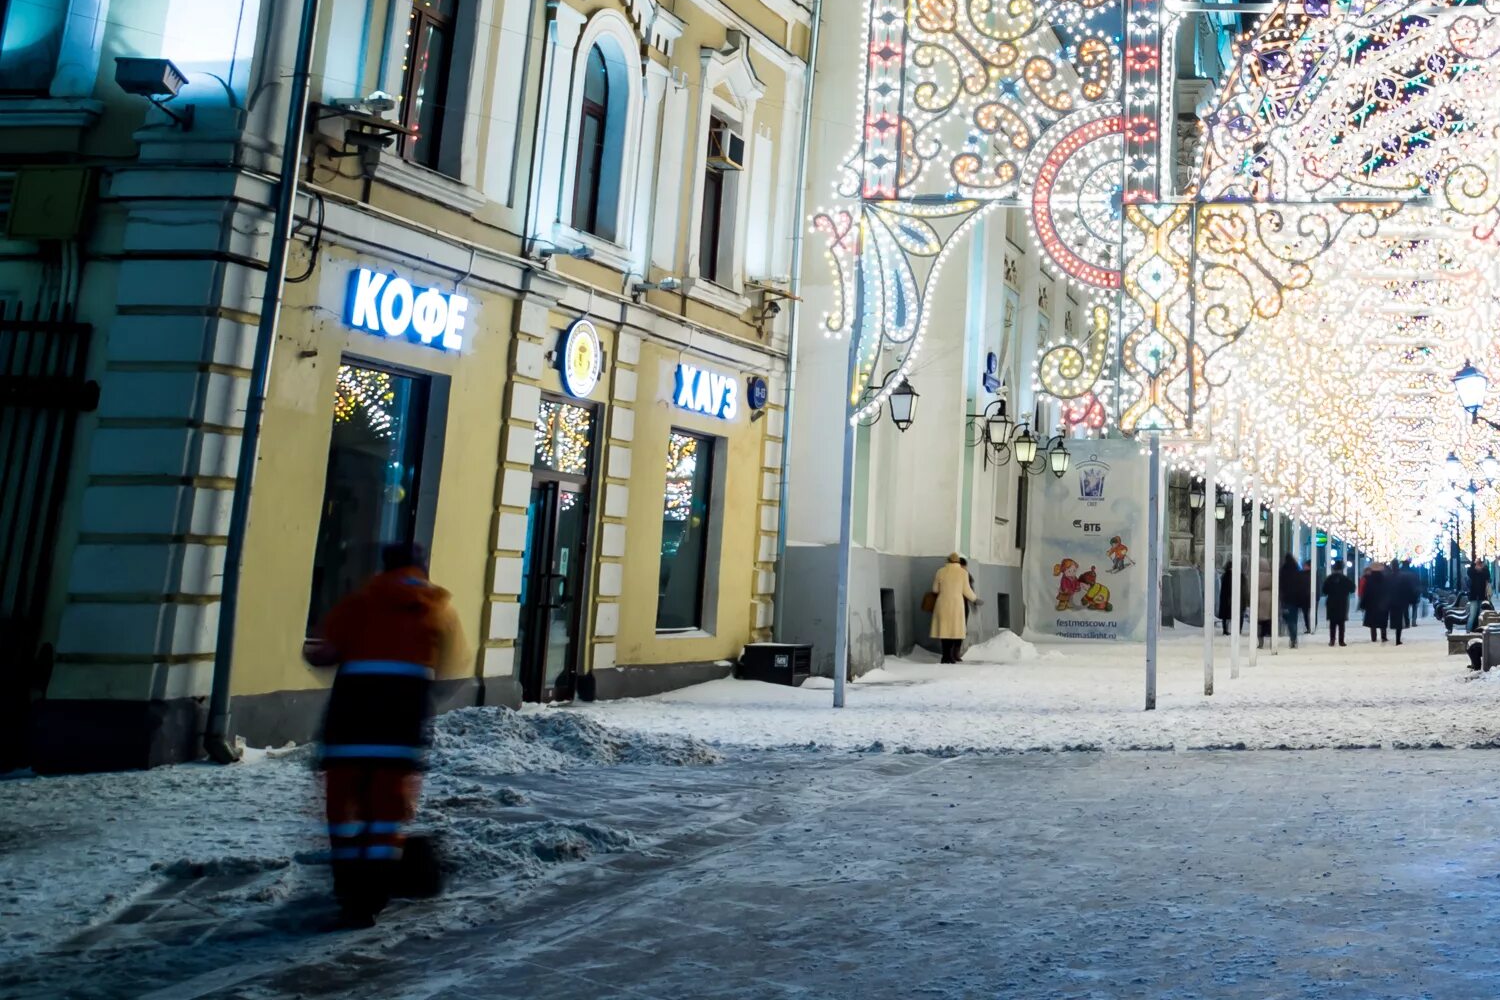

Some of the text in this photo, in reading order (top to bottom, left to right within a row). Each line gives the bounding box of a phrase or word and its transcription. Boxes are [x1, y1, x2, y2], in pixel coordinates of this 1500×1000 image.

[352, 268, 468, 350] КОФЕ
[678, 364, 738, 420] ХАУЗ
[1083, 523, 1101, 532] ВТБ
[1056, 619, 1117, 628] festmoscow.ru
